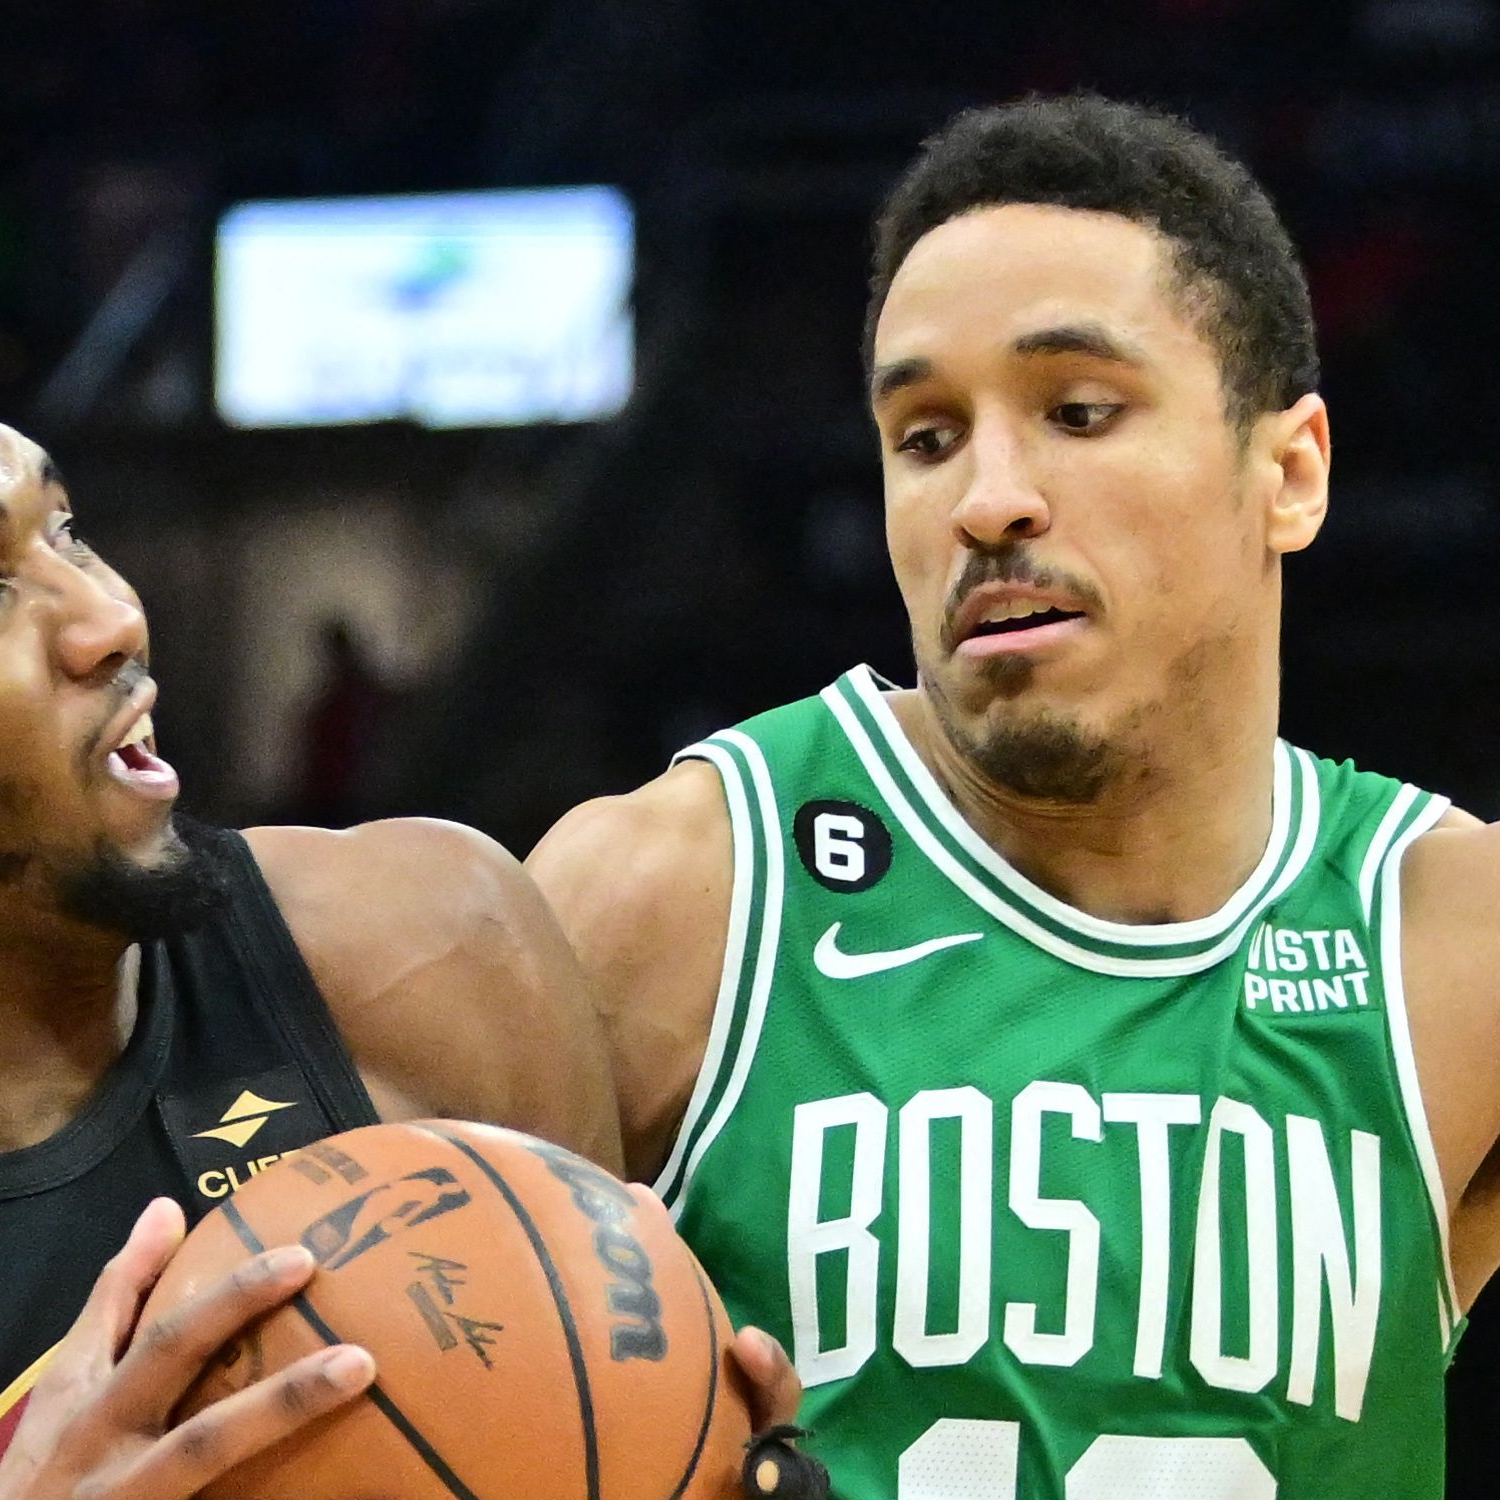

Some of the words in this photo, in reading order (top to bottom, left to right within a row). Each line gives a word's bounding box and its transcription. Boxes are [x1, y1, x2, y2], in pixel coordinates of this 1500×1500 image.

[814, 812, 865, 882] 6
[1247, 921, 1367, 971] VISTA
[1244, 970, 1370, 1012] PRINT
[197, 1148, 301, 1198] CLI
[788, 1081, 1381, 1422] BOSTON
